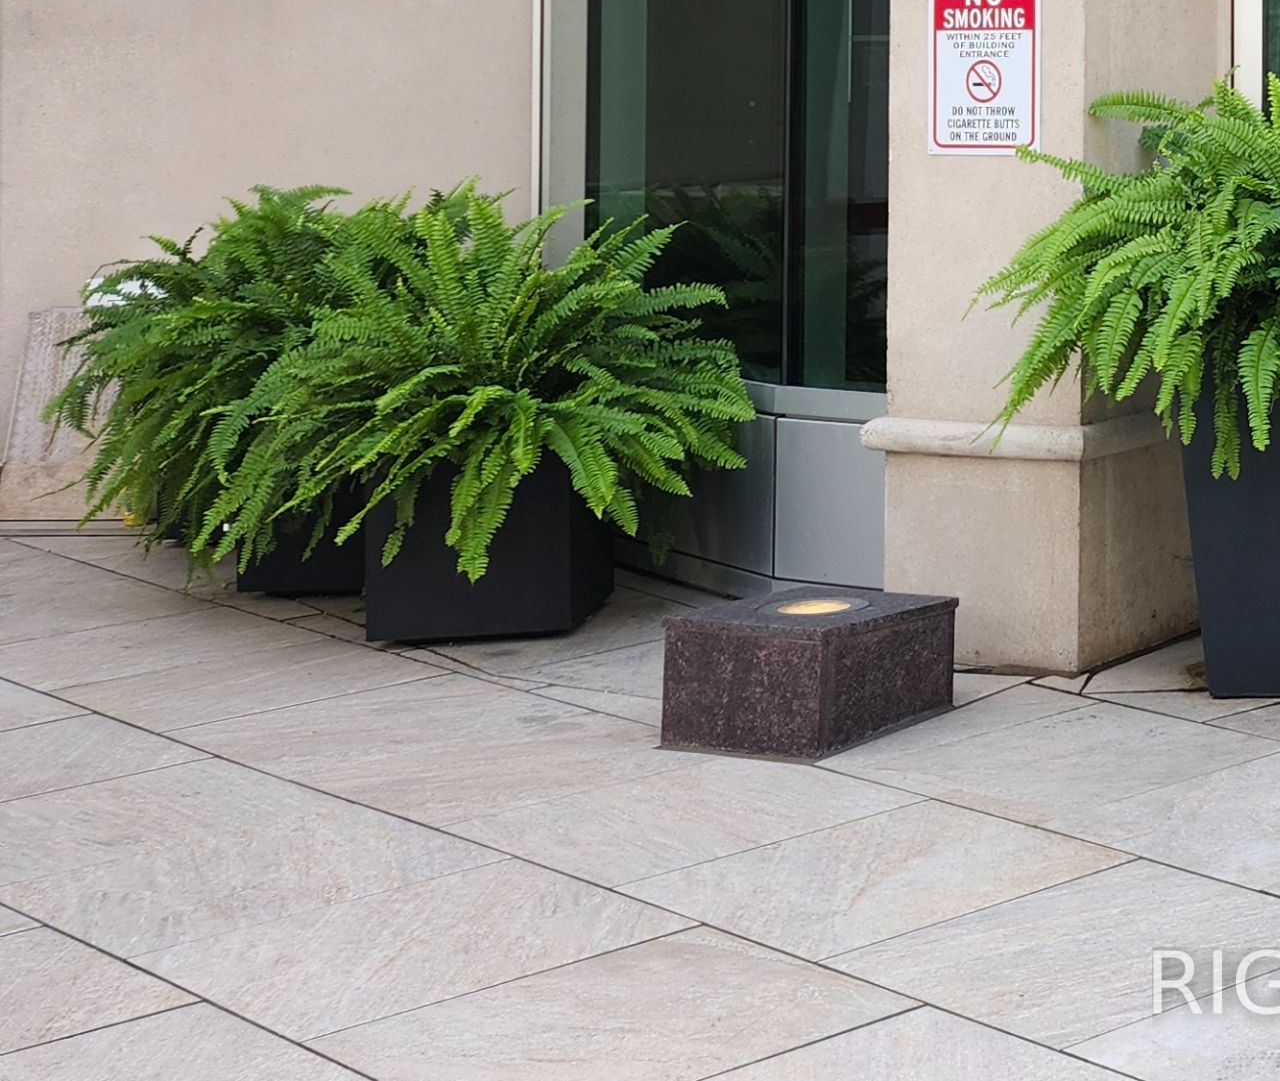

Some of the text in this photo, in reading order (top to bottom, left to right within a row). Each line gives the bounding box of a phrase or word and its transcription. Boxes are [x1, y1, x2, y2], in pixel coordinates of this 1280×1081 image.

[943, 8, 1025, 29] SMOKING
[946, 32, 1023, 40] WITHIN 25 FEET
[953, 41, 1015, 49] OF BUILDING
[959, 50, 1010, 58] ENTRANCE
[952, 106, 1016, 116] DO NOT THROW
[947, 119, 1020, 129] CIGARETTE BUTTS
[950, 131, 1017, 141] ON THE GROUND
